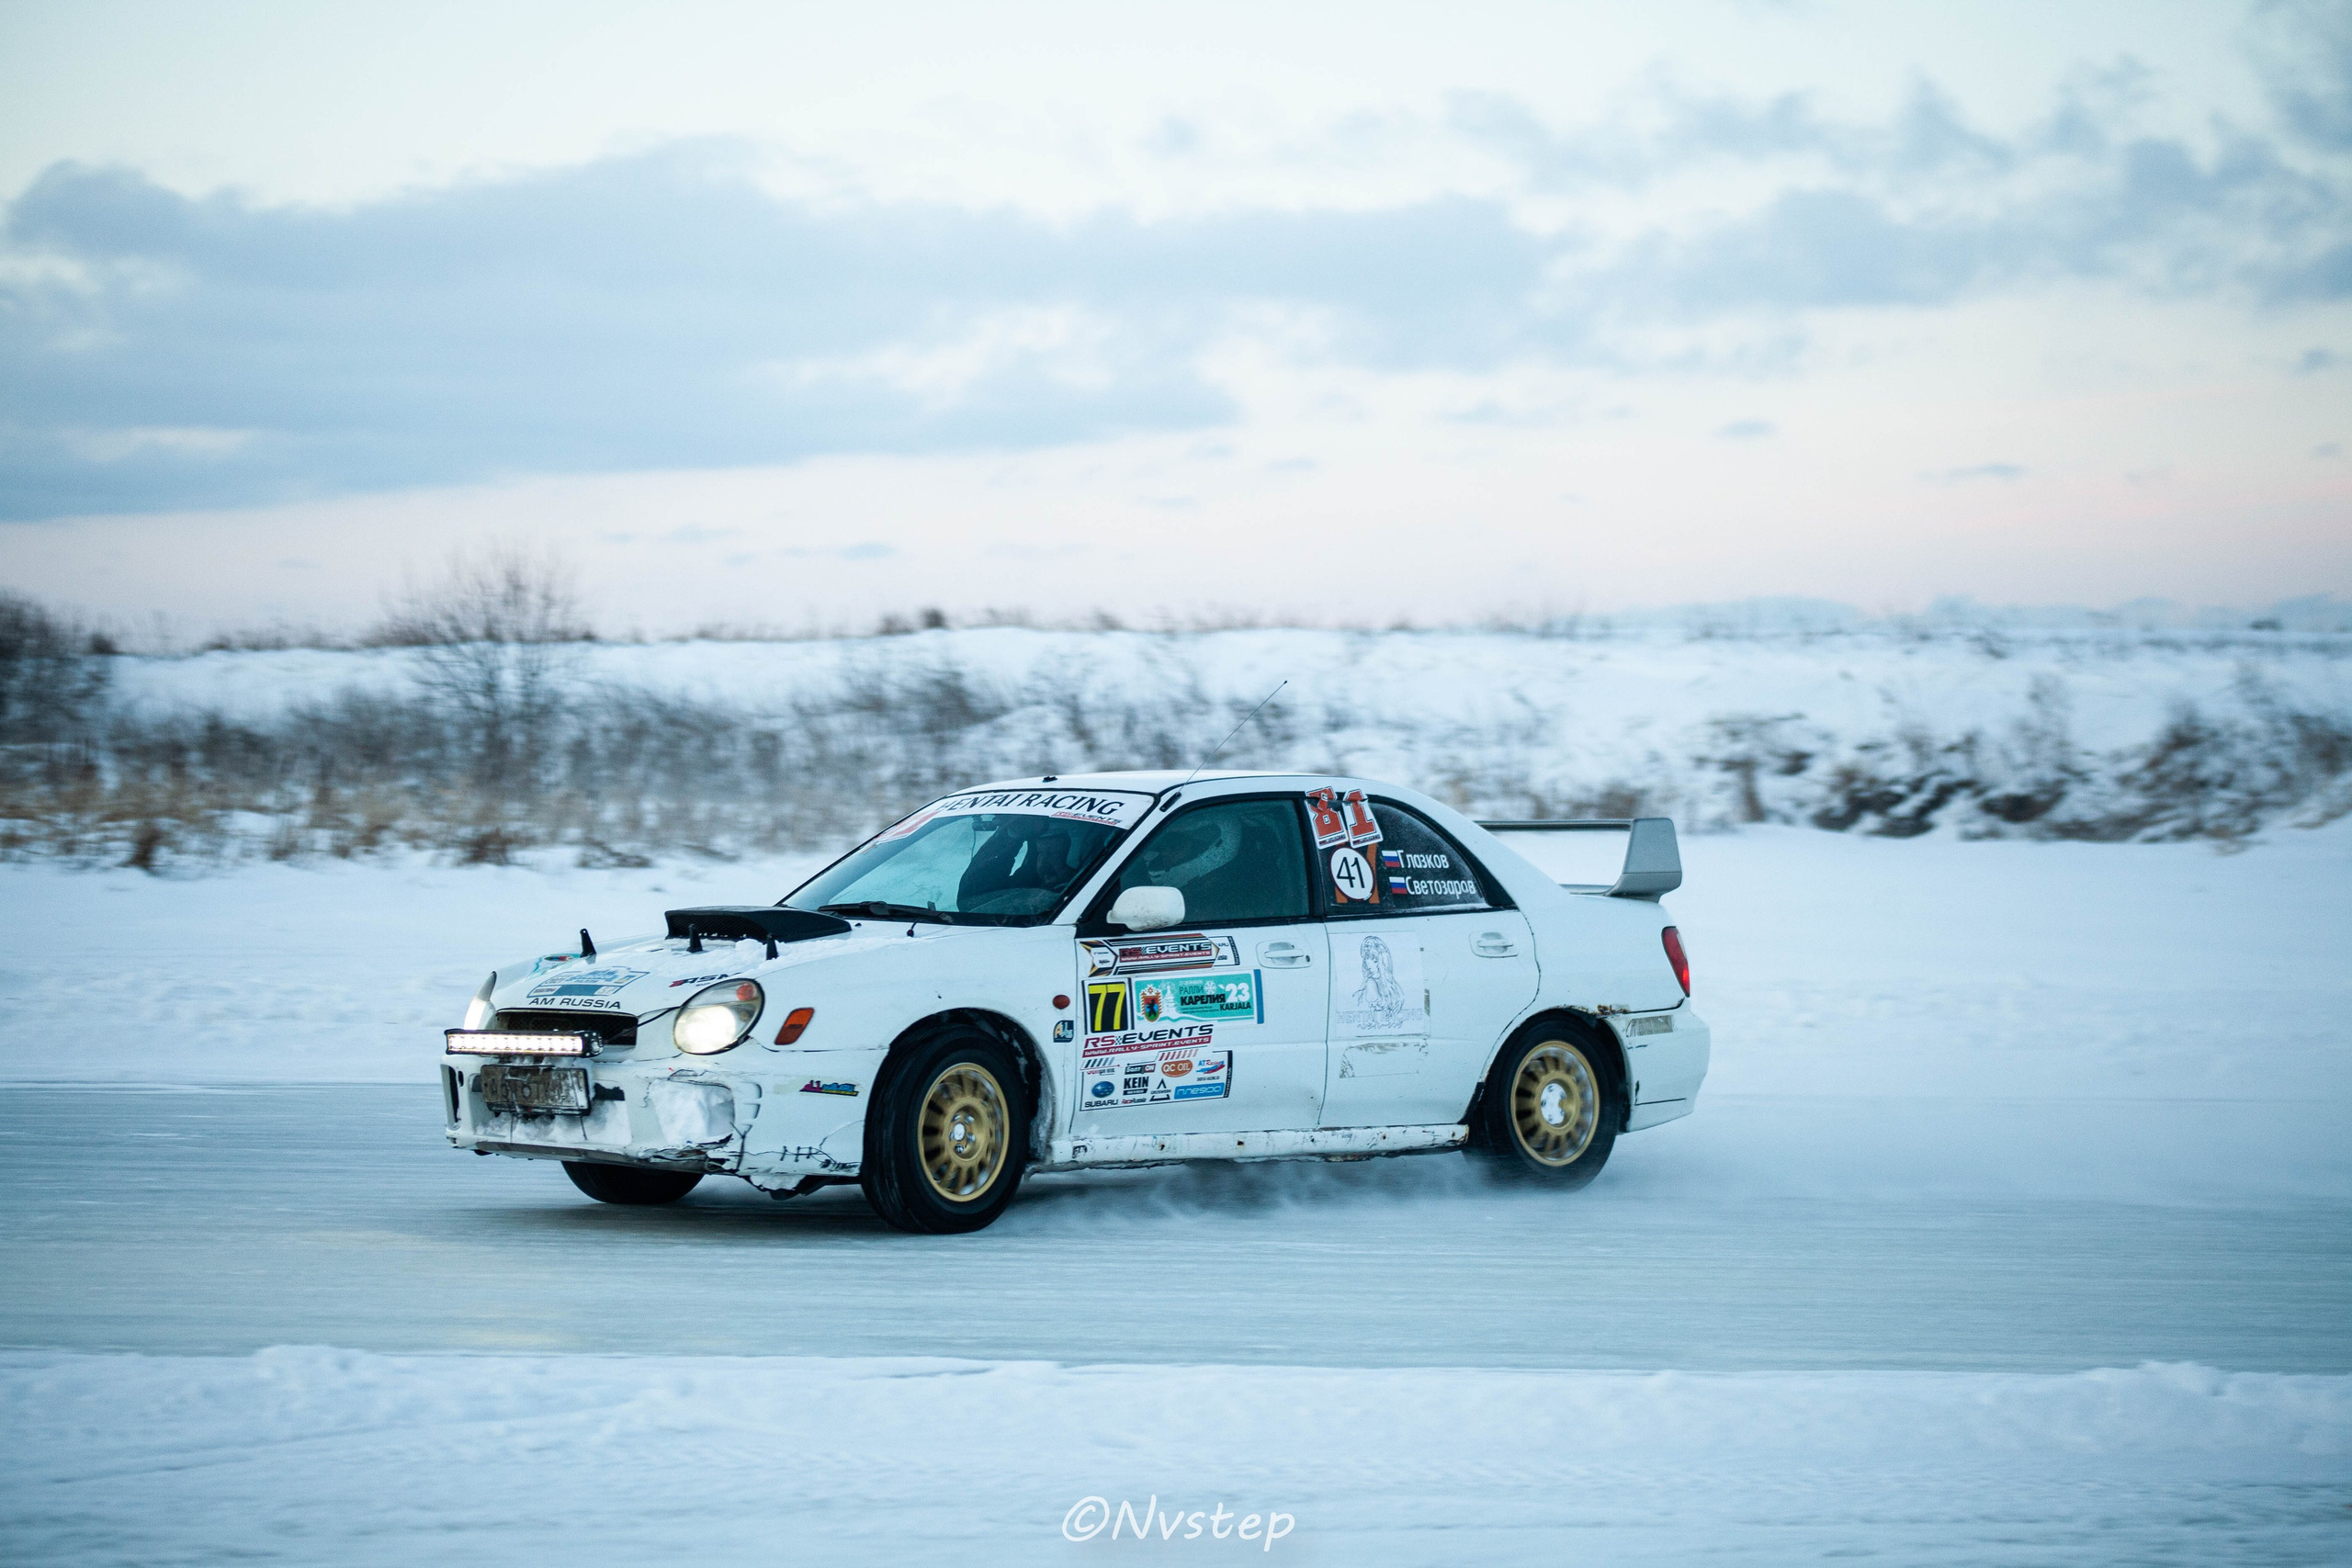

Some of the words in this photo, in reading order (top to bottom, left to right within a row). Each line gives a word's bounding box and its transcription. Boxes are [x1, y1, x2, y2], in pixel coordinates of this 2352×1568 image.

[935, 794, 1023, 811] HENTAI
[1018, 794, 1125, 816] RACING
[1398, 850, 1449, 869] Глазков
[1336, 856, 1365, 888] 41
[1406, 876, 1476, 899] Светозаров
[1146, 942, 1212, 954] EVENTS
[1180, 986, 1204, 995] РАЛЛИ
[529, 998, 556, 1006] AM
[560, 998, 621, 1010] RUSSIA
[1181, 994, 1226, 1006] КАРЕЛИЯ
[1089, 984, 1125, 1032] 77
[1219, 1002, 1251, 1011] KARJALA
[1084, 1035, 1115, 1049] RS
[1122, 1024, 1214, 1044] EVENTS
[1163, 1064, 1176, 1072] QC
[1177, 1063, 1191, 1071] OIL
[1124, 1077, 1149, 1089] KEIN
[1085, 1100, 1119, 1108] SUBARU
